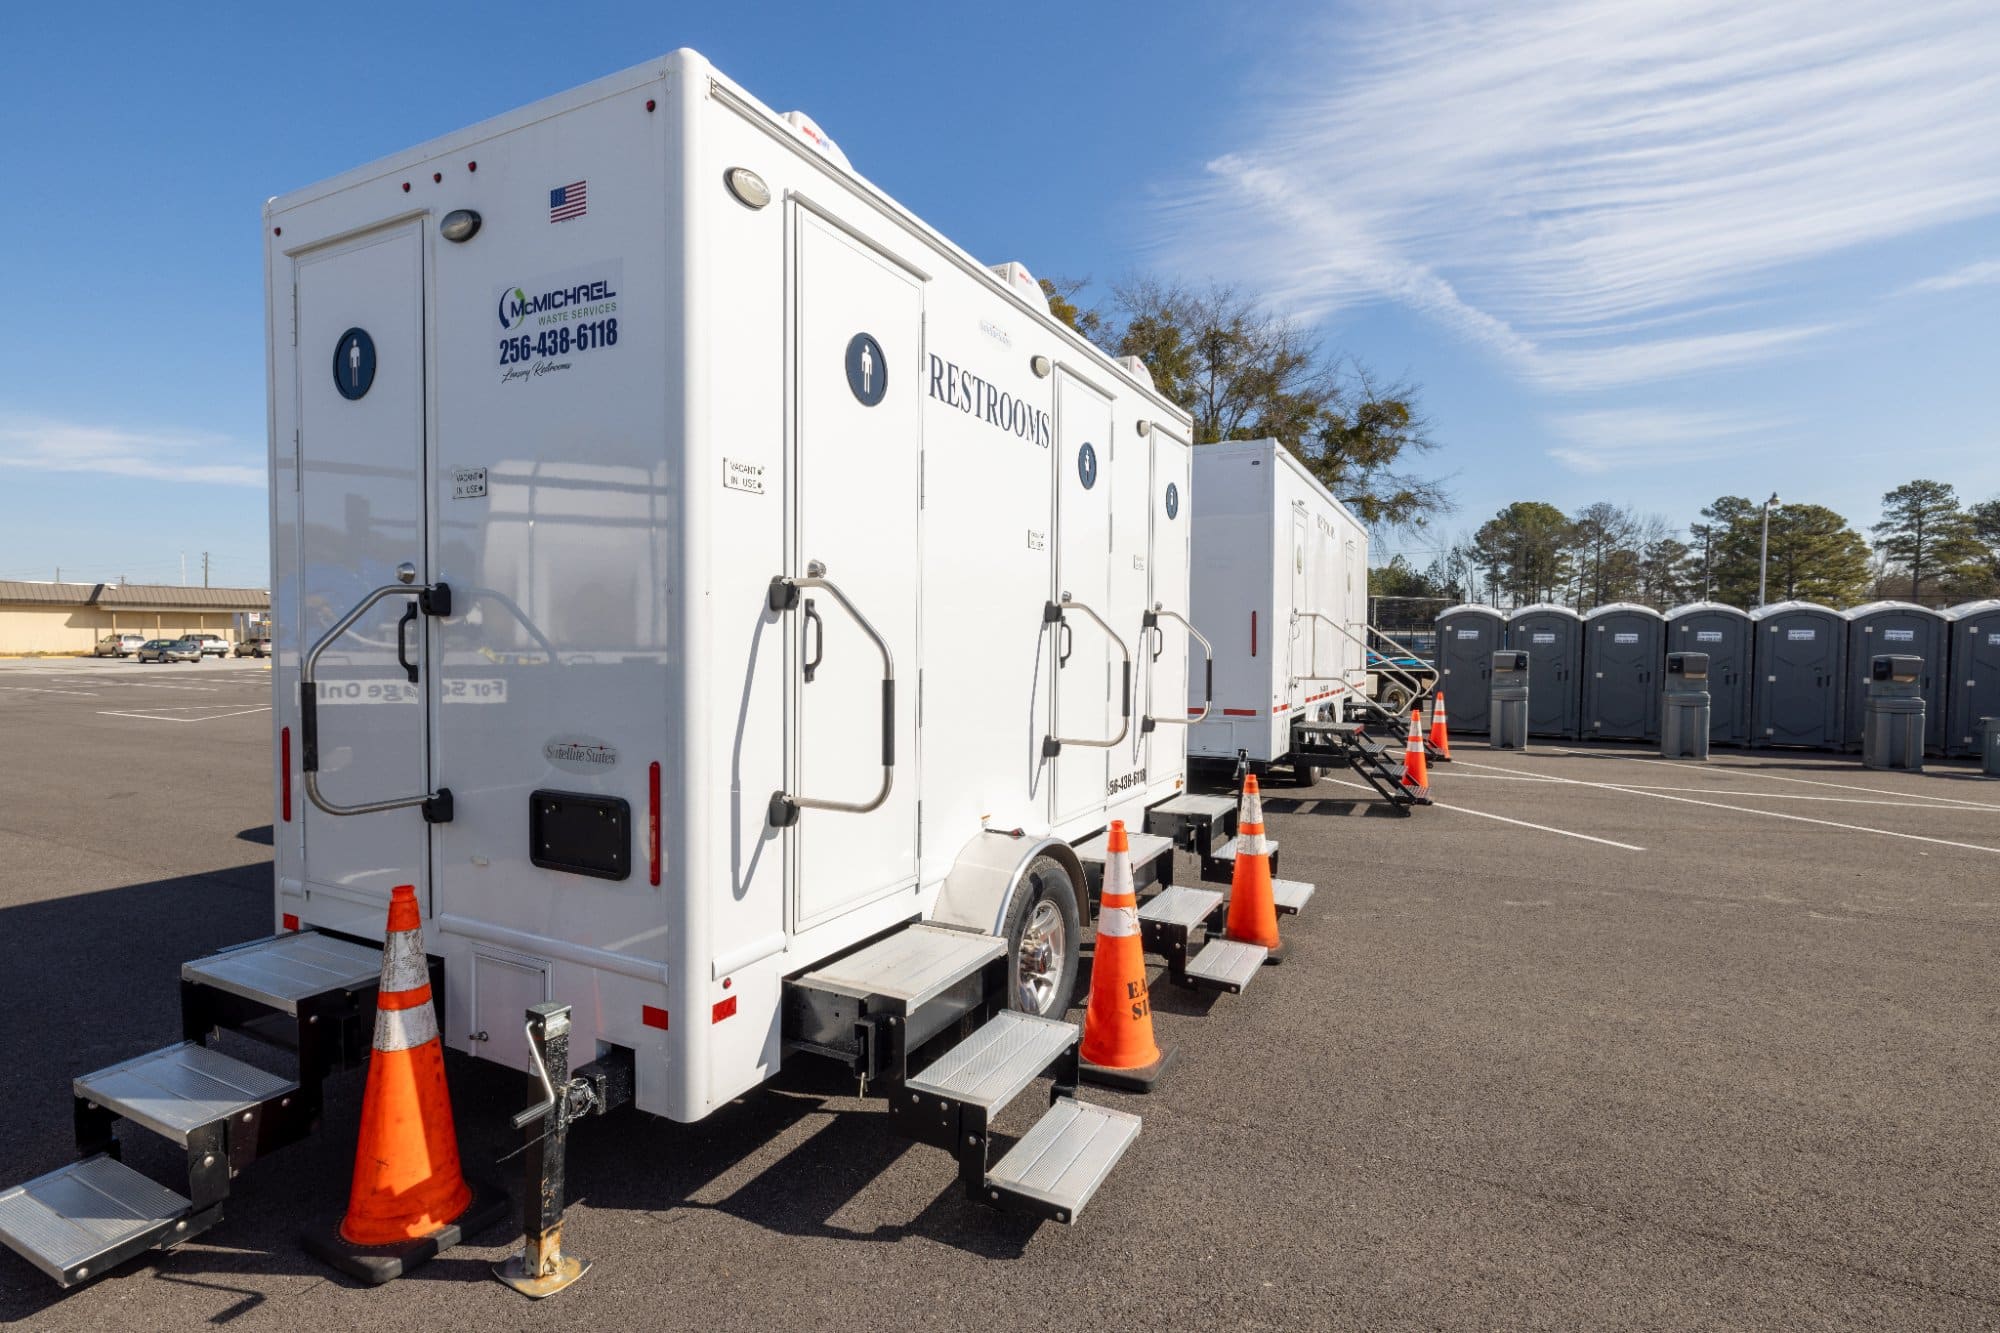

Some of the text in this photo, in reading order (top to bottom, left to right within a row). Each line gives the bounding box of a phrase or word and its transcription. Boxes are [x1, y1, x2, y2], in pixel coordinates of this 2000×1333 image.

[538, 302, 617, 326] WASTE SERVICES
[499, 318, 618, 365] 256-438-6118
[928, 352, 1050, 449] RESTROOMS
[730, 461, 756, 475] VACANT
[730, 476, 757, 489] IN USE
[585, 748, 616, 764] Suites
